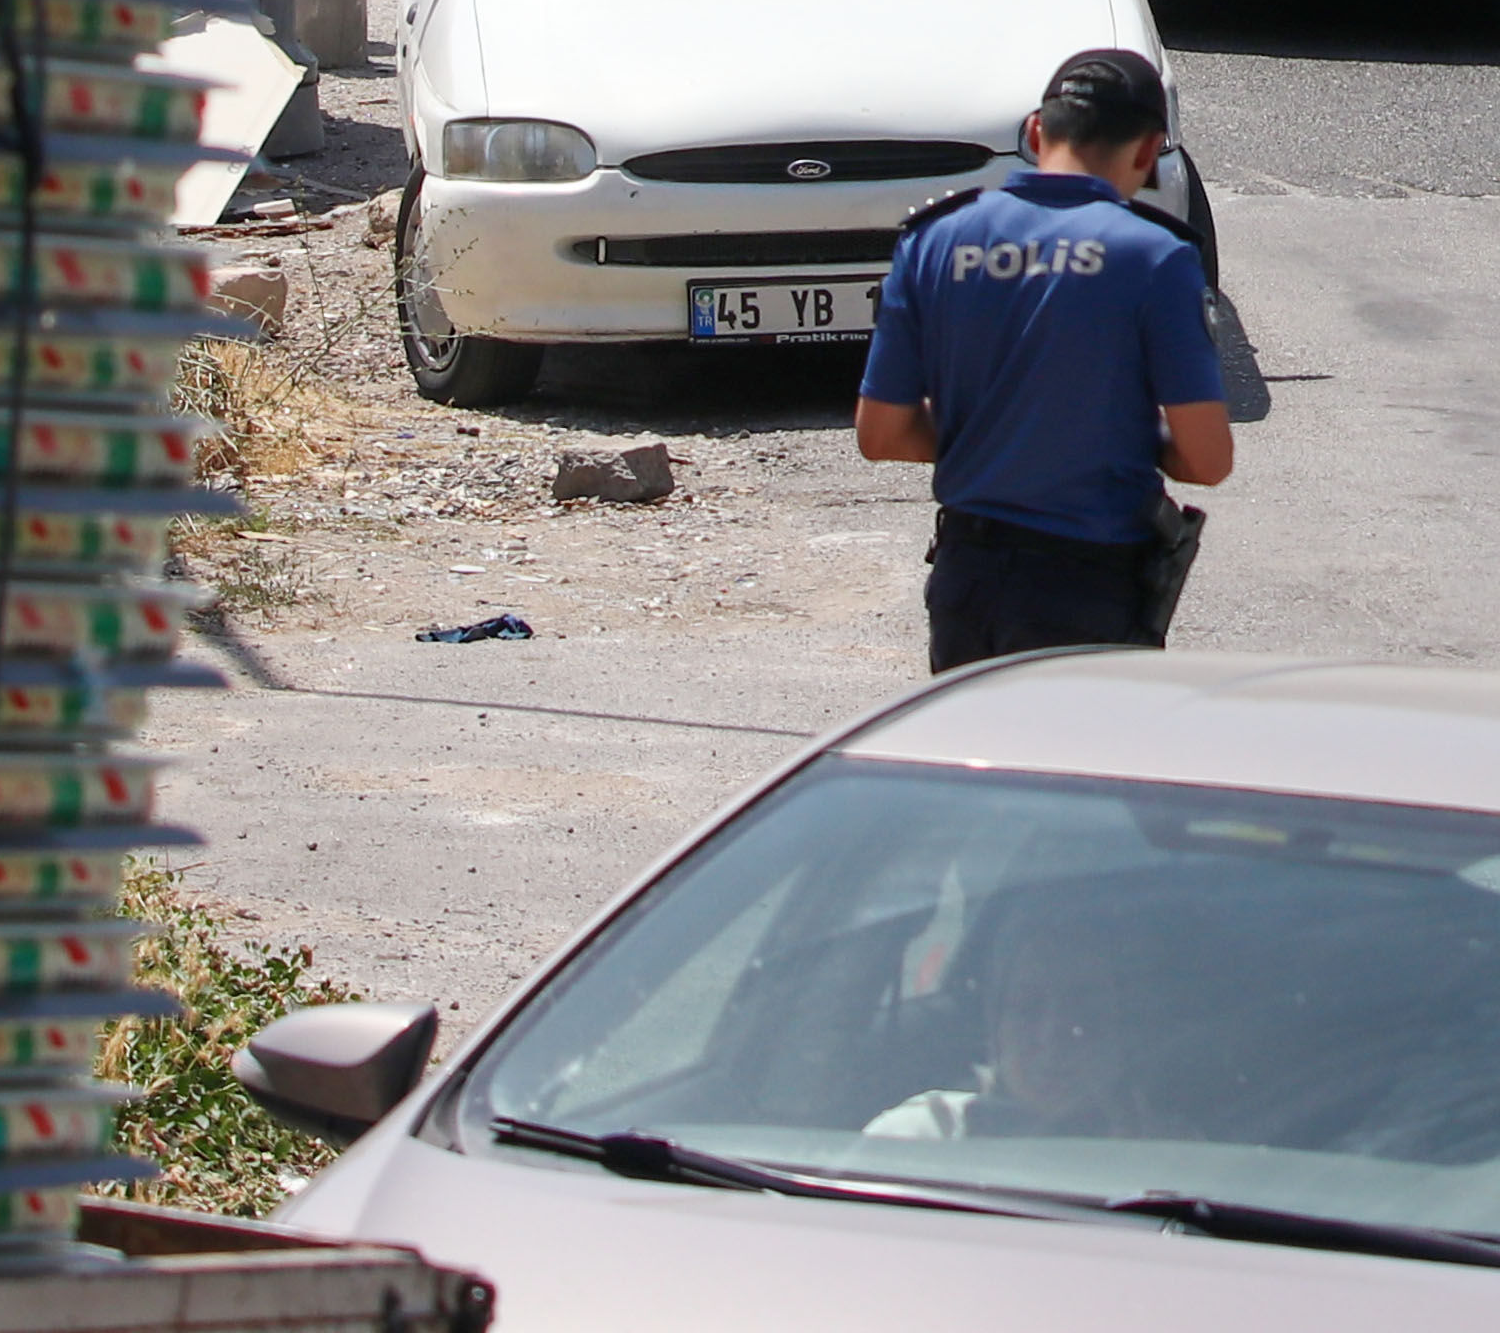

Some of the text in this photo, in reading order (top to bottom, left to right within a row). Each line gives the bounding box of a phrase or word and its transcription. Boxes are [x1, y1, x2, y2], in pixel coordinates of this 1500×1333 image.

[698, 315, 713, 327] TR
[717, 291, 761, 330] 45
[790, 289, 834, 328] YB
[775, 332, 838, 344] Pratik
